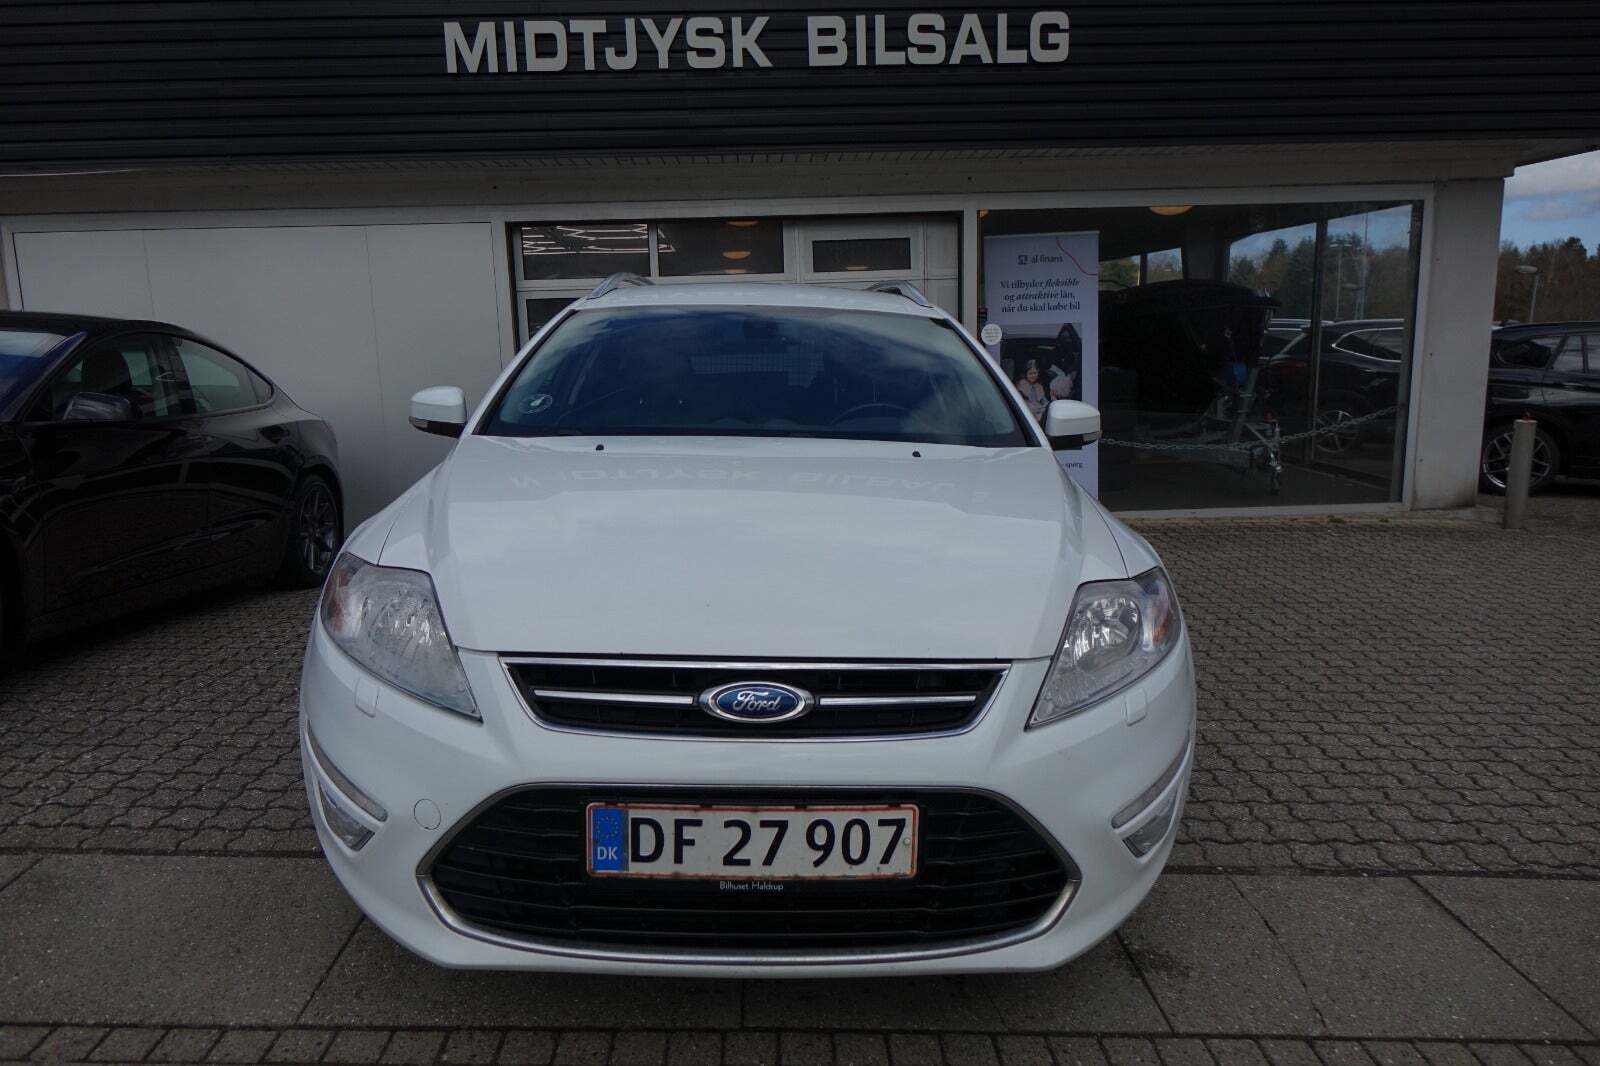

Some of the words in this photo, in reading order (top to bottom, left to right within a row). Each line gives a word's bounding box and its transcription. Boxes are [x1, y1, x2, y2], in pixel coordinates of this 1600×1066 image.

[443, 15, 773, 74] MIDTJYSK
[807, 11, 1071, 67] BILSALG
[1000, 280, 1010, 289] Vi
[1011, 279, 1044, 290] tilbyder
[1044, 277, 1080, 290] fleksible
[1004, 294, 1014, 302] og
[1016, 292, 1059, 301] attraktive
[1002, 303, 1016, 312] når
[1017, 303, 1028, 312] du
[1030, 302, 1046, 311] skal
[1047, 301, 1068, 311] købe
[1069, 301, 1080, 310] bil
[732, 690, 781, 711] Ford
[596, 846, 619, 861] DK
[629, 817, 703, 865] DF
[722, 818, 789, 867] 27
[805, 817, 907, 868] 907
[719, 880, 749, 890] Bilhuset
[751, 880, 784, 892] Haldrup
